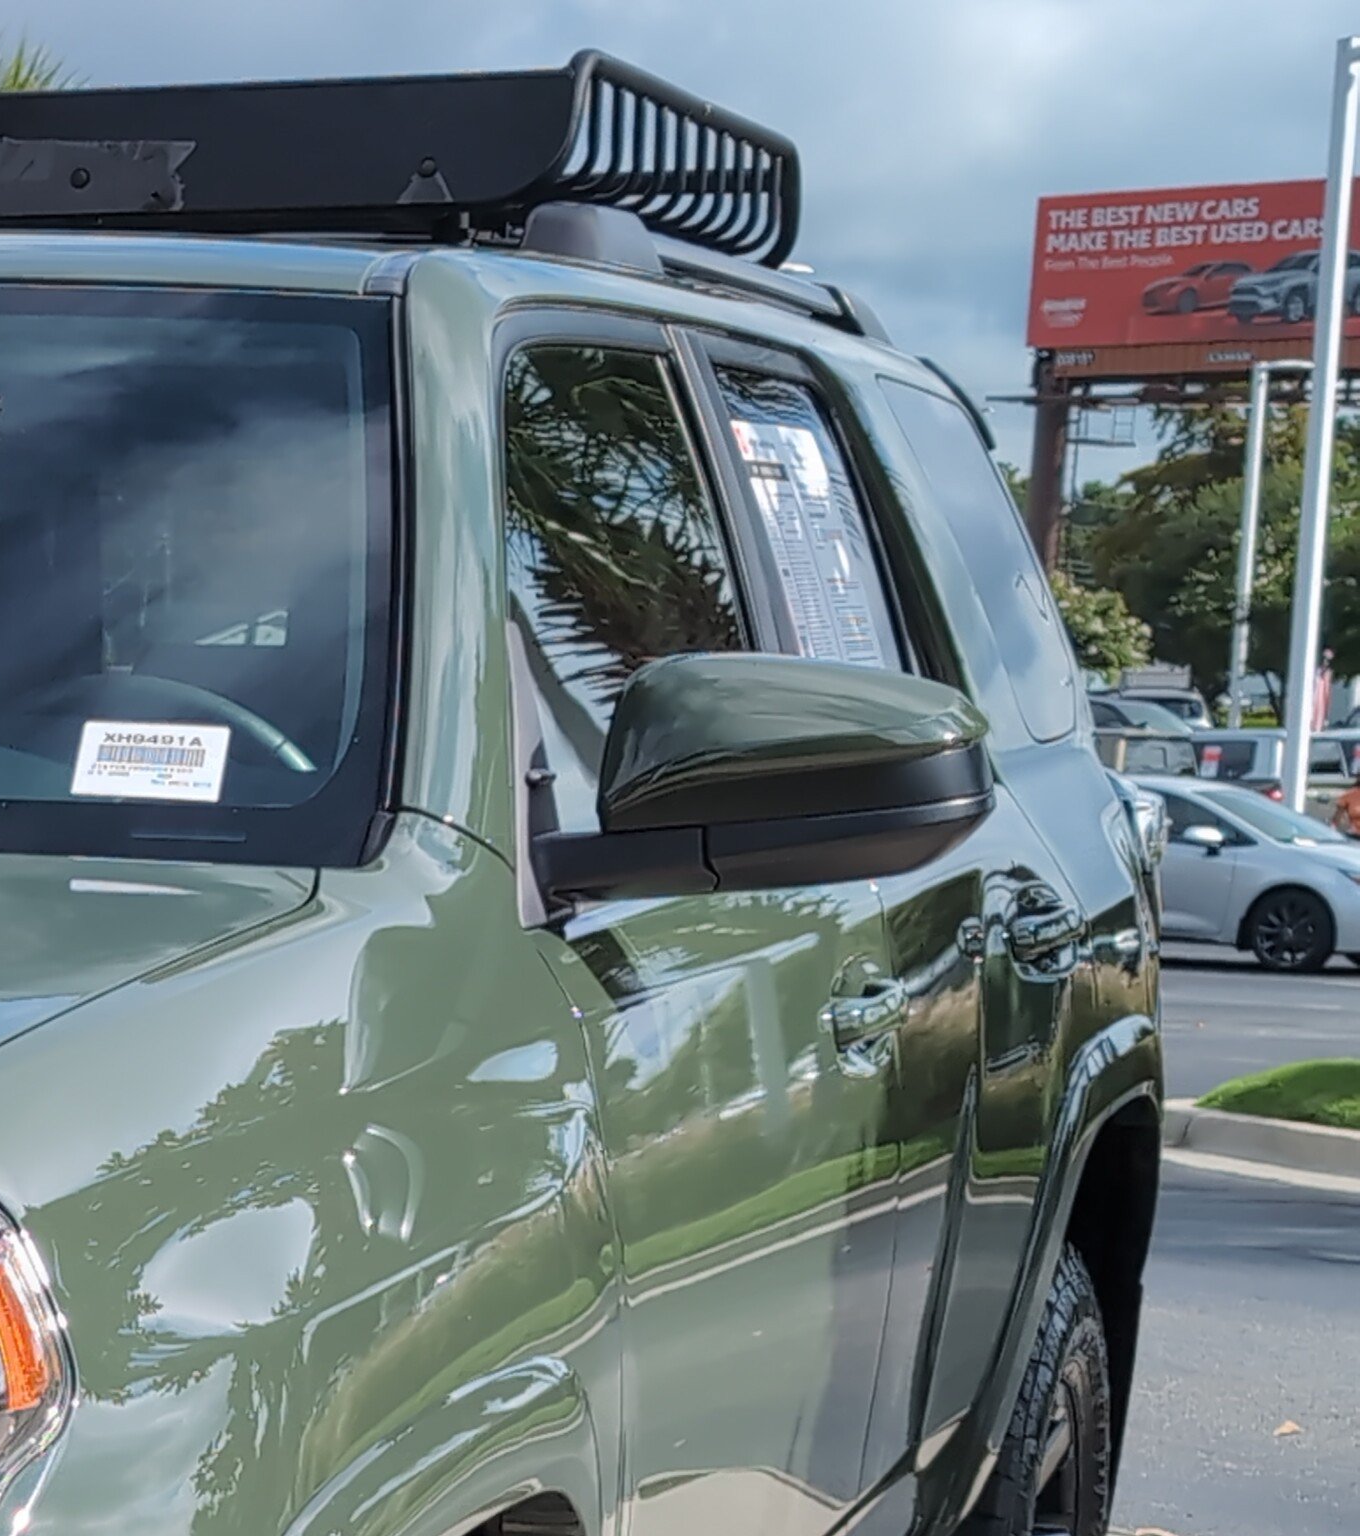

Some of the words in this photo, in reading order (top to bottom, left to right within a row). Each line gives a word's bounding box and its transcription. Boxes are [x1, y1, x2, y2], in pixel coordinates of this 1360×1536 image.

[1048, 209, 1088, 230] THE
[1091, 205, 1142, 227] BEST
[1144, 201, 1199, 224] NEW
[1200, 198, 1260, 220] CARS
[1045, 231, 1108, 253] MAKE
[1111, 227, 1152, 250] THE
[1154, 223, 1207, 247] BEST
[1210, 220, 1269, 244] USED
